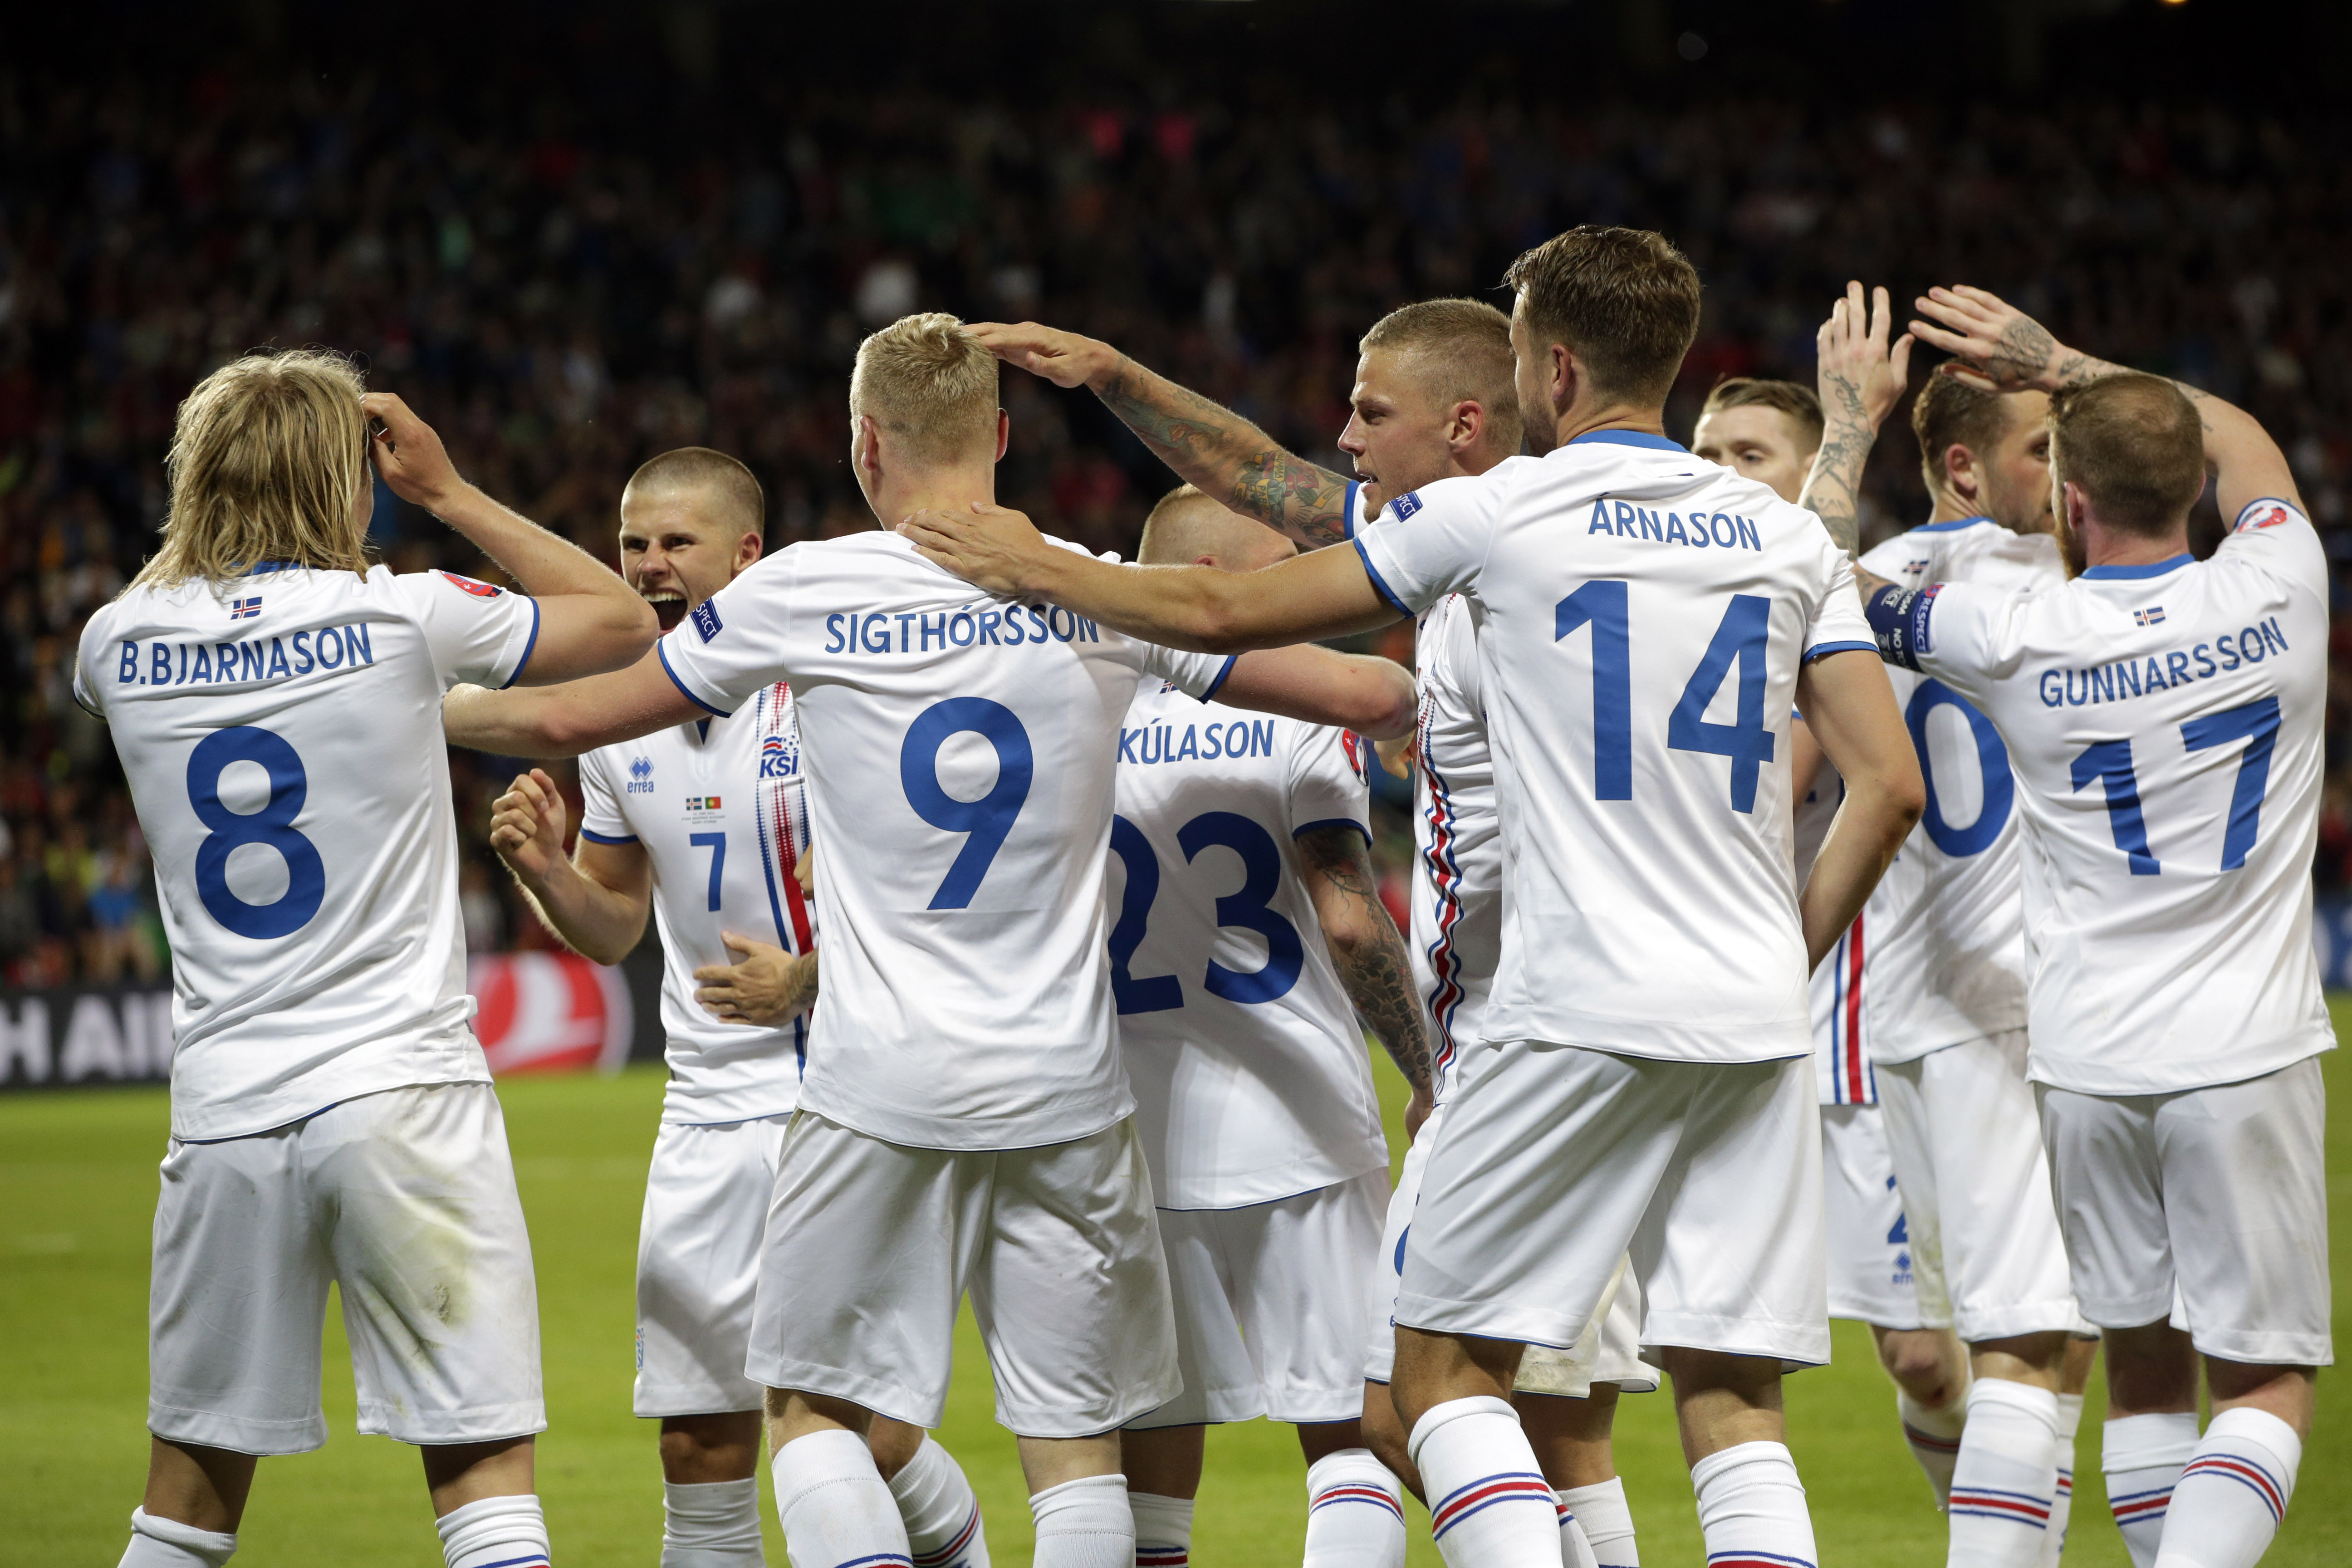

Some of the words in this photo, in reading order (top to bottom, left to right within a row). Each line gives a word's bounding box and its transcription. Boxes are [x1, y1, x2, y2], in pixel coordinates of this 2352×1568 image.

[118, 623, 373, 686] B.BJARNASON
[695, 602, 717, 636] SPECT
[825, 604, 1099, 653] SIGTHÓRSSON
[1893, 628, 1902, 649] NO
[1916, 597, 1932, 652] RESPECT
[1555, 580, 1775, 814] 14
[2040, 617, 2289, 708] GUNNARSSON
[1117, 717, 1275, 764] KÚLASON
[1905, 677, 2015, 858] 0
[901, 696, 1034, 911] 9
[2070, 696, 2283, 876] 17
[186, 725, 326, 940] 8
[690, 832, 726, 912] 7
[1110, 812, 1304, 1015] 23
